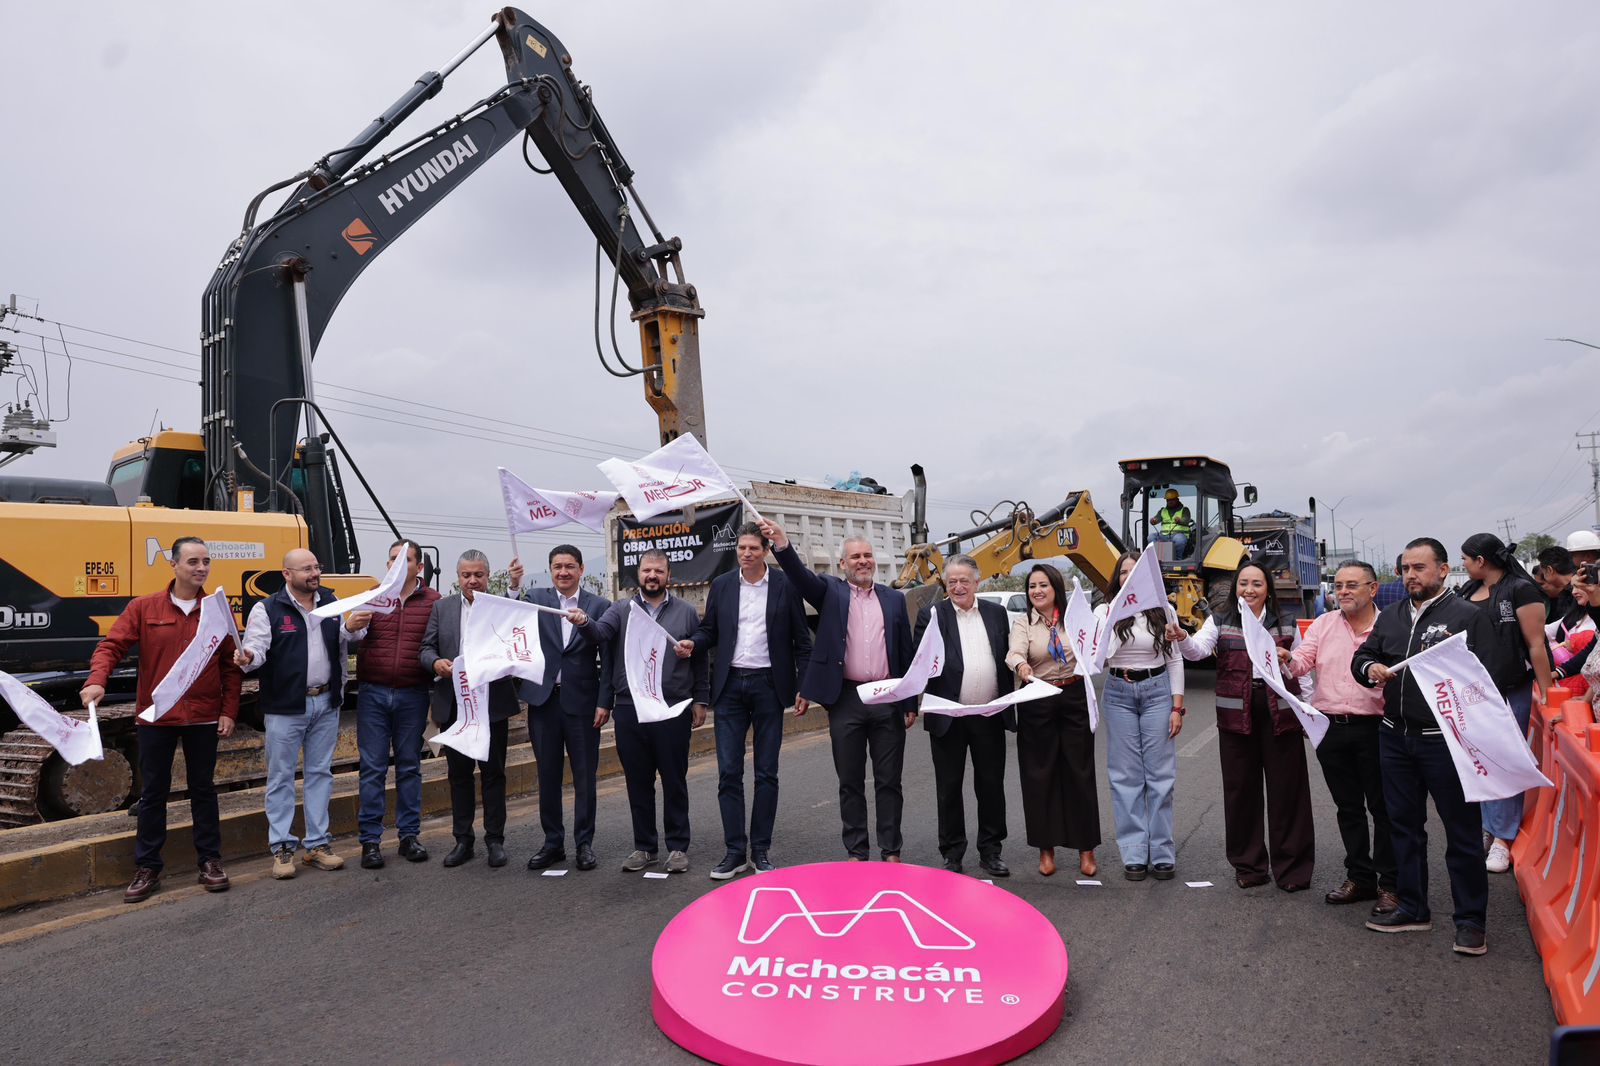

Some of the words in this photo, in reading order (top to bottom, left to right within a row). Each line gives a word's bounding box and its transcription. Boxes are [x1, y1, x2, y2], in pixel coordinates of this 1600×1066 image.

[377, 134, 479, 216] HYUNDAI
[643, 478, 706, 503] MEJOR
[623, 521, 691, 540] PRECAUCIÓN
[1057, 528, 1075, 547] CAT
[623, 541, 654, 553] OBRA
[656, 535, 703, 550] ESTATAL
[85, 562, 115, 575] EPE-05
[624, 554, 638, 567] EN
[726, 955, 983, 983] Michoacán
[721, 981, 985, 1005] CONSTRUYE
